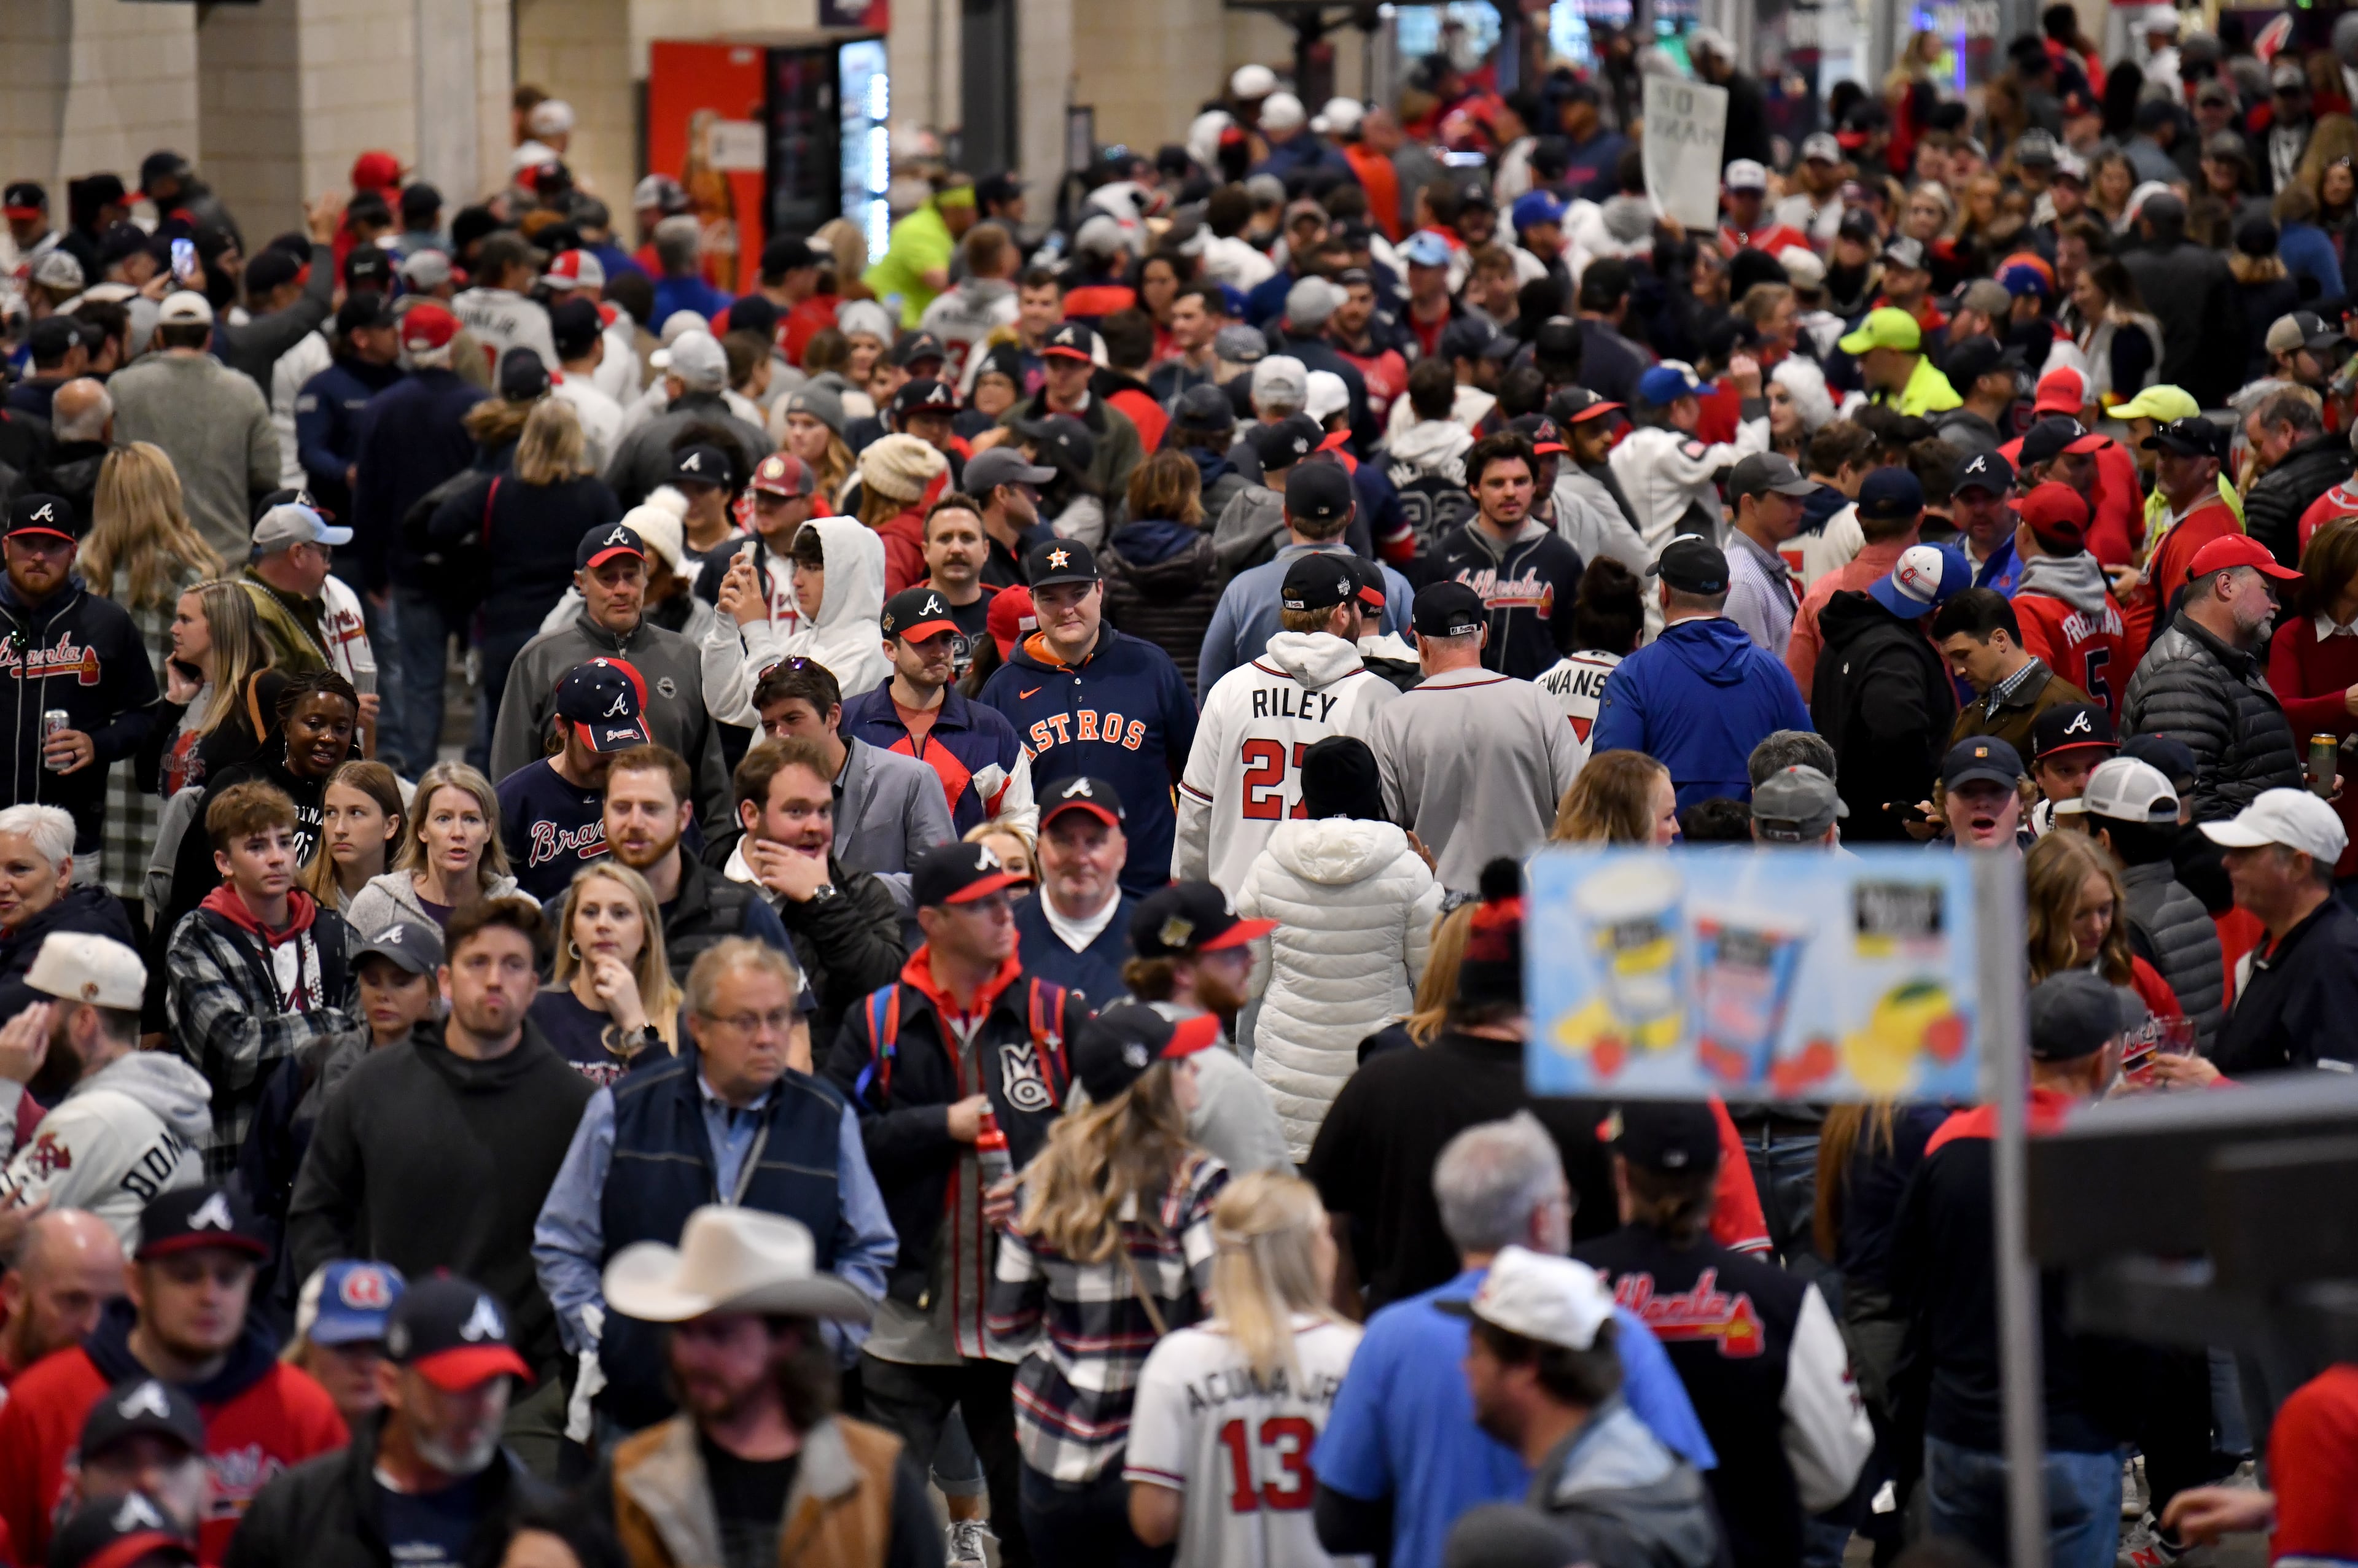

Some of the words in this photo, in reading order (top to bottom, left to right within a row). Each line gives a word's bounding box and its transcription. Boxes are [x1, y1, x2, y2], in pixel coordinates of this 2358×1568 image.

[680, 452, 701, 472] A
[1964, 454, 1987, 474] A
[30, 502, 53, 522] A
[603, 526, 629, 546] A
[1050, 550, 1068, 567] H
[918, 594, 943, 616] A
[0, 629, 81, 667] tlanta
[2085, 646, 2115, 715] 5
[603, 693, 629, 718] A
[1253, 686, 1338, 723] RILEY
[2064, 710, 2091, 735] A
[1061, 776, 1092, 799] A
[373, 924, 404, 944] A
[187, 1191, 233, 1232] A
[1597, 1267, 1733, 1327] tlanta
[458, 1292, 505, 1343] A
[1220, 1416, 1318, 1513] 13
